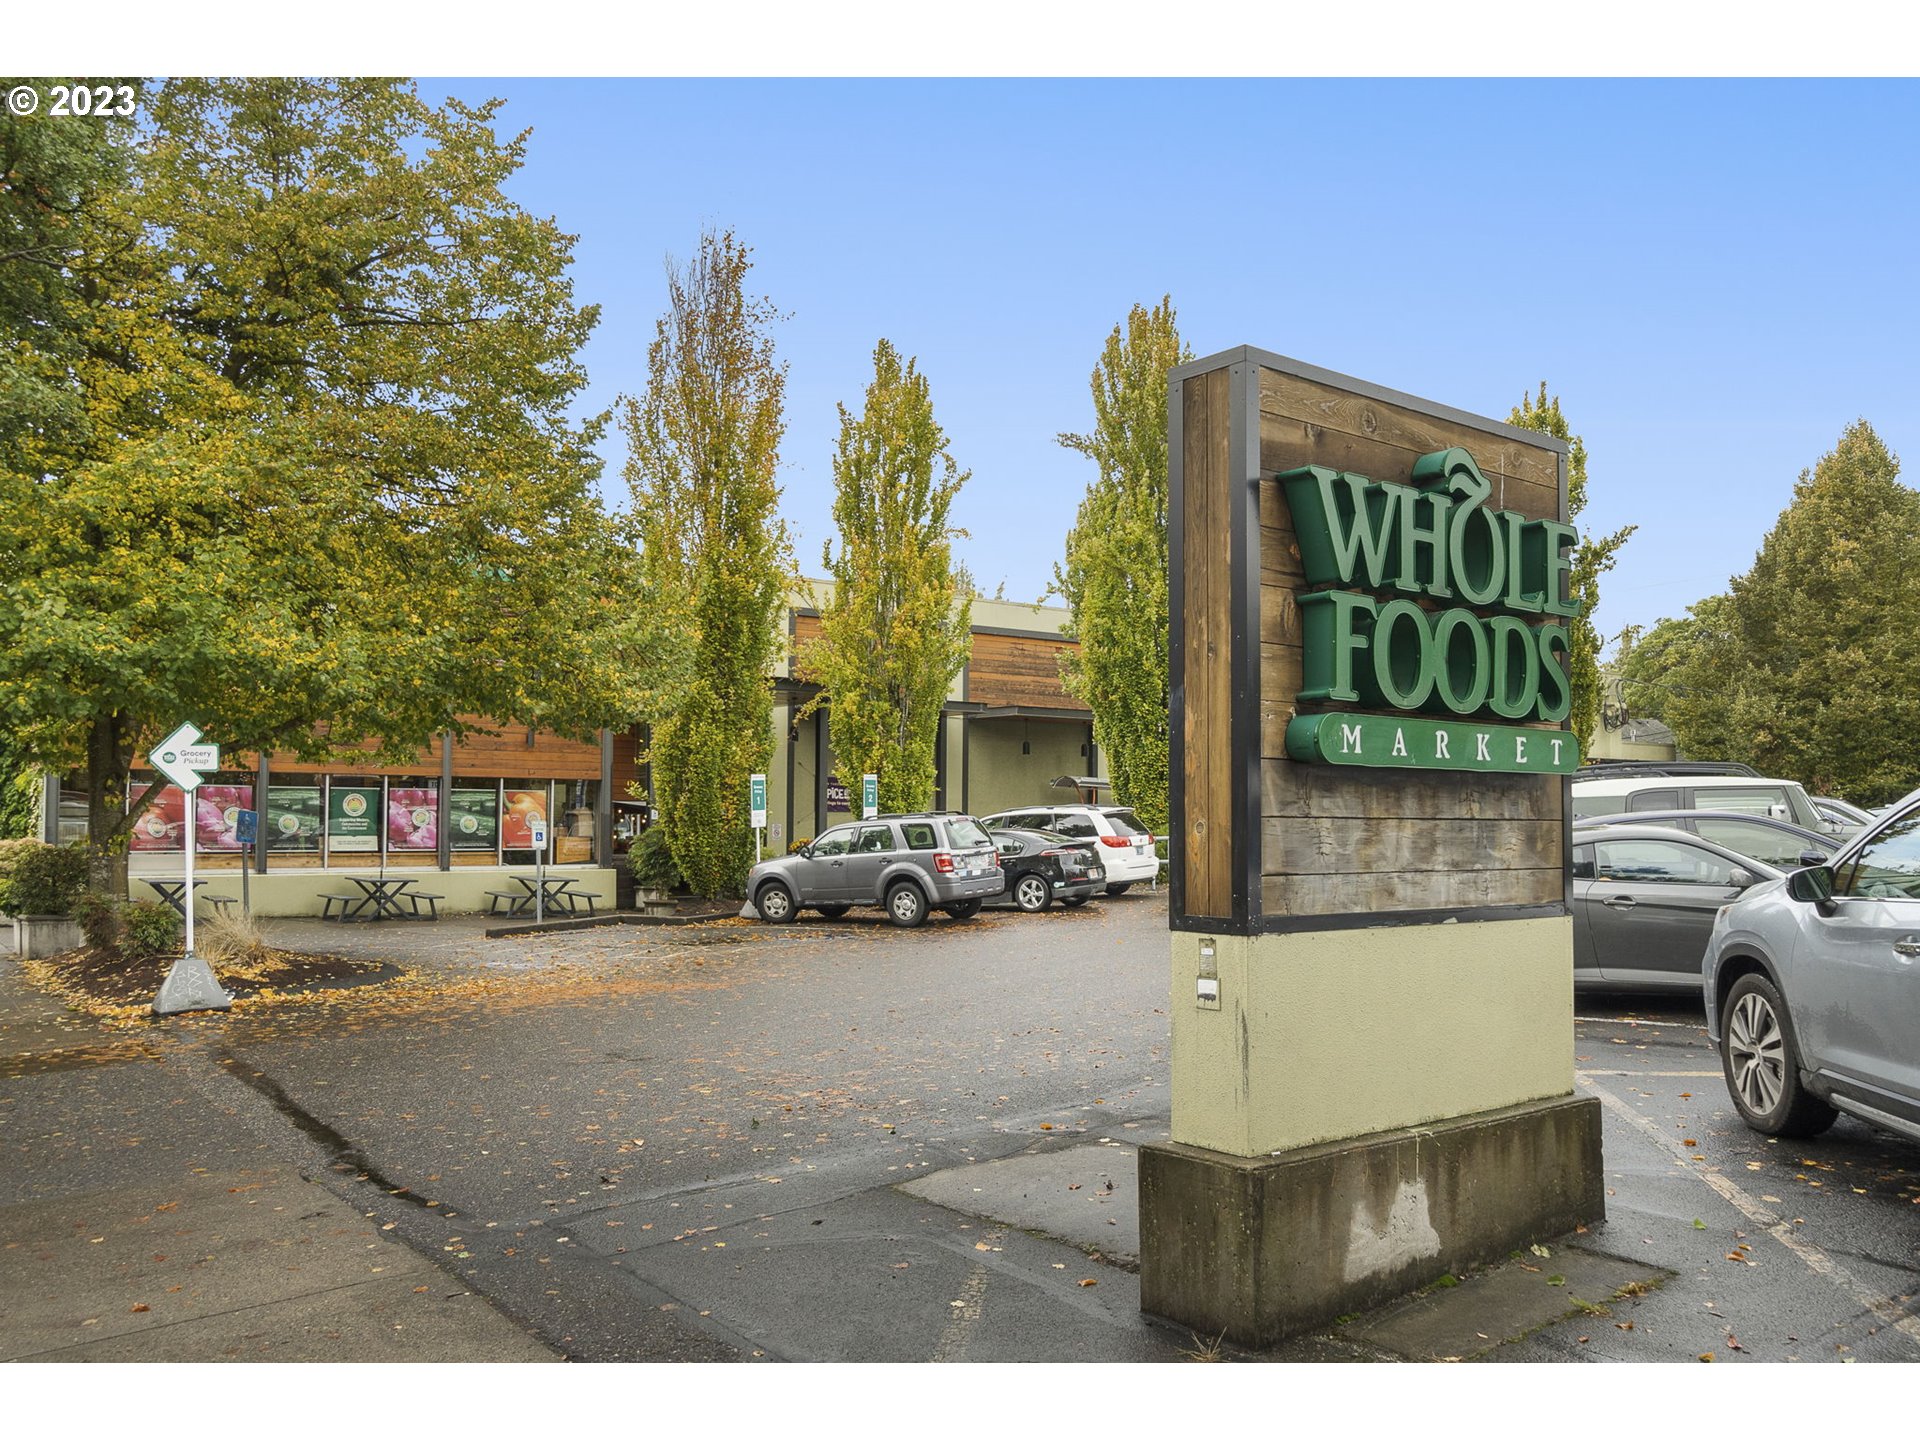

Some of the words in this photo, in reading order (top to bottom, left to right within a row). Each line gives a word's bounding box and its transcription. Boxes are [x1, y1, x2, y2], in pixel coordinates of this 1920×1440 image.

[1308, 446, 1581, 618] WHOLE
[1330, 589, 1573, 723] FOODS
[184, 757, 209, 765] Pickup
[1340, 723, 1564, 767] MARKET
[868, 794, 873, 803] 2
